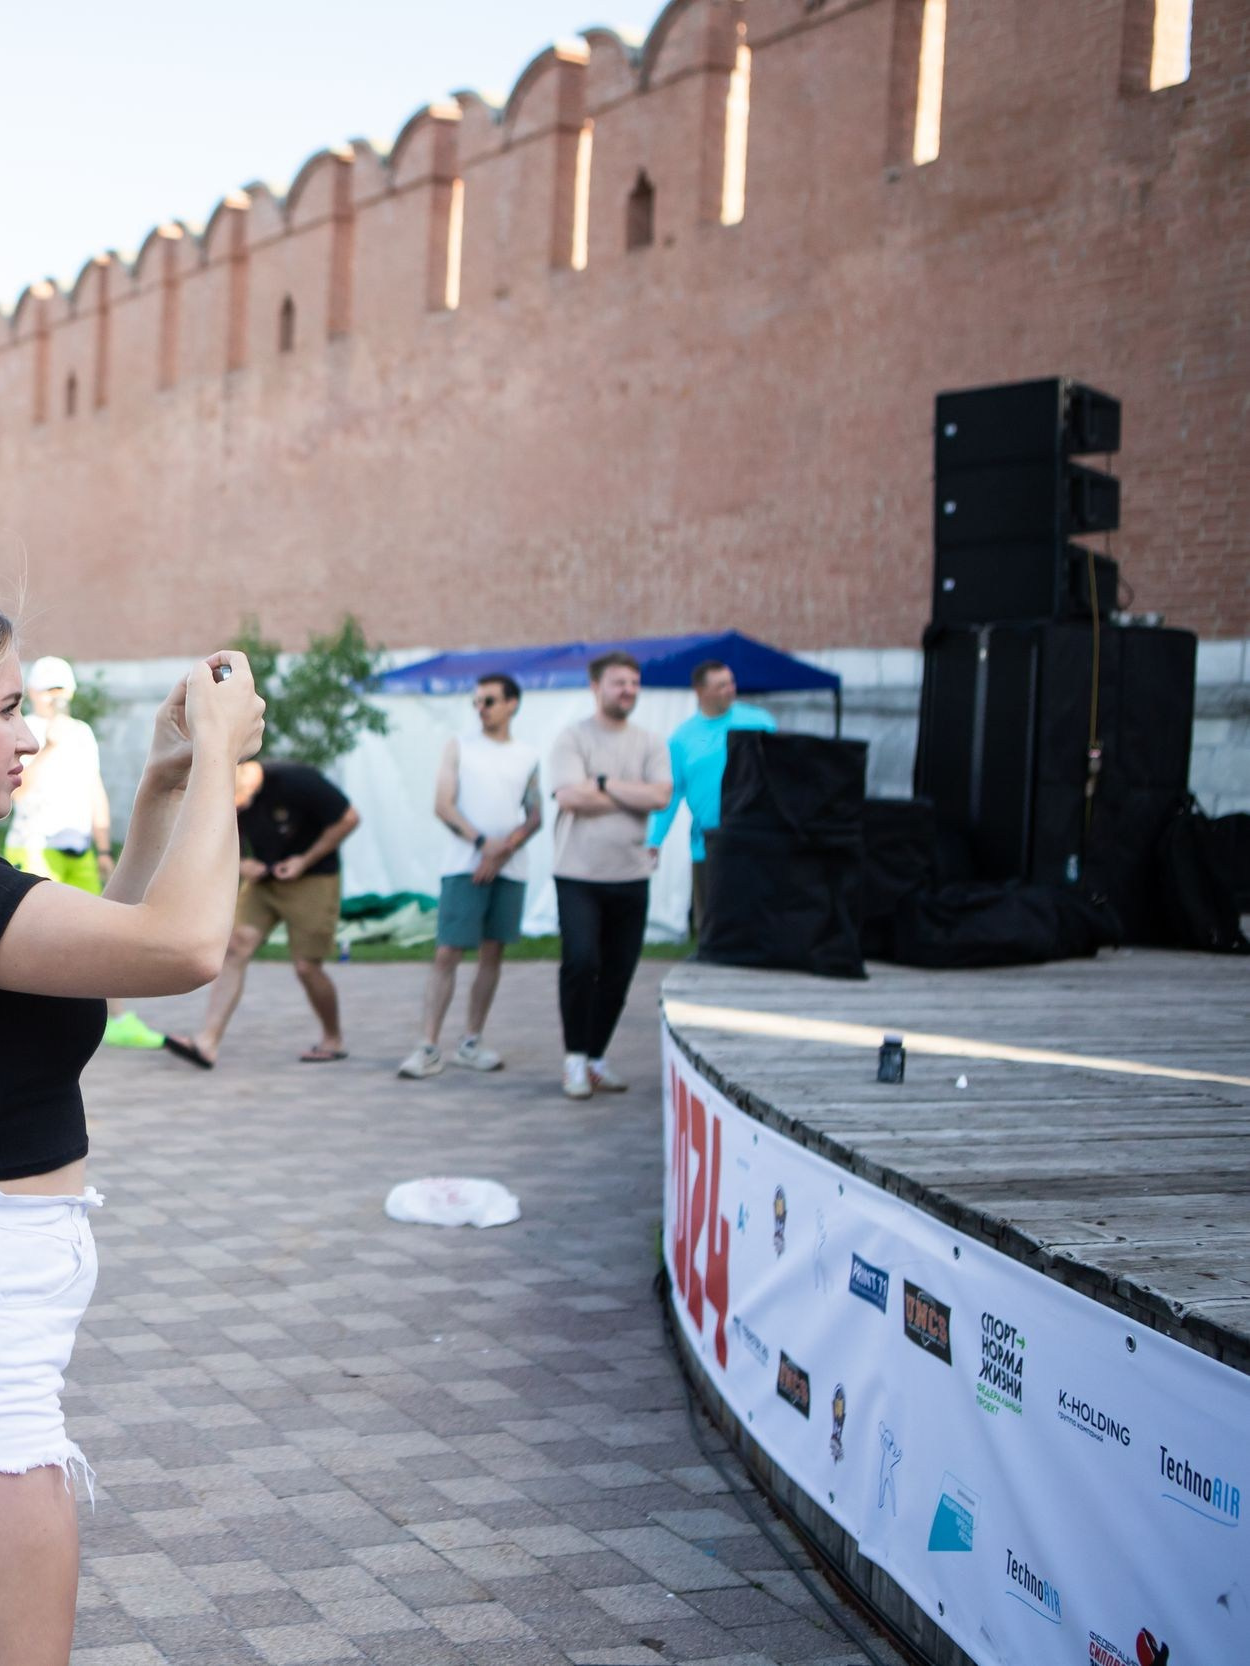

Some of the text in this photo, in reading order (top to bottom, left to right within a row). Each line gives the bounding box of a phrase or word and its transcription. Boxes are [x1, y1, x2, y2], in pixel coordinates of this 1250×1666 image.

[877, 1276, 887, 1299] 71
[981, 1312, 1017, 1349] СПОРТ
[982, 1334, 1023, 1378] НОРМА
[979, 1358, 1022, 1402] ЖИЗНИ
[1058, 1388, 1131, 1447] K-HOLDING
[1160, 1445, 1240, 1520] TechnoAIR
[1006, 1548, 1062, 1619] TechnoAIR
[1089, 1630, 1140, 1666] ФЕДЕРАЦИ
